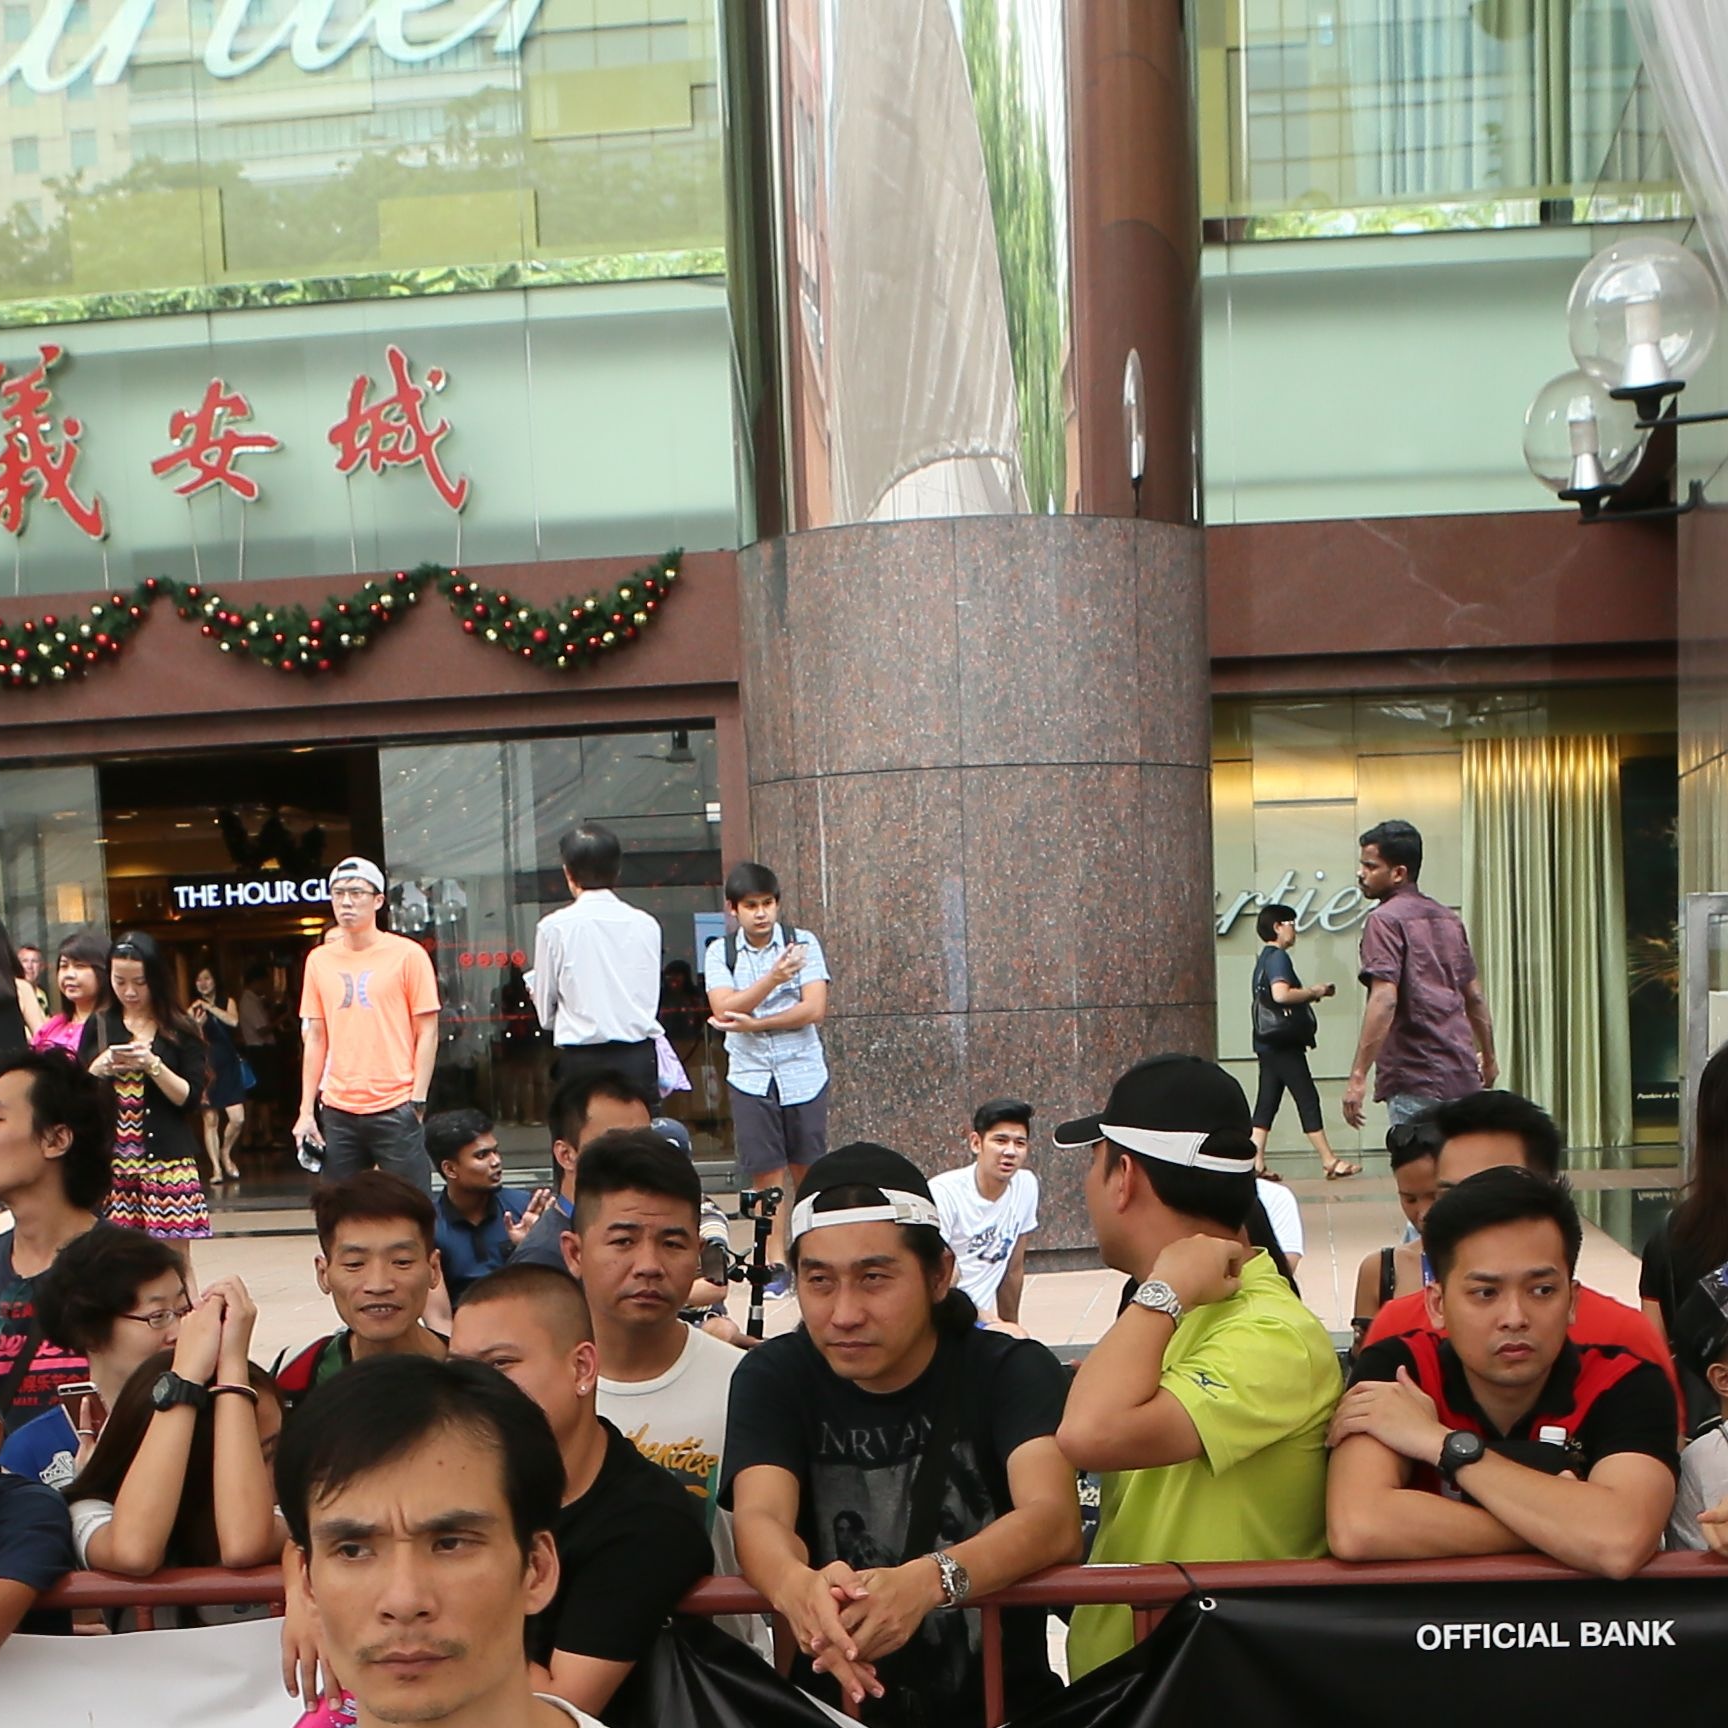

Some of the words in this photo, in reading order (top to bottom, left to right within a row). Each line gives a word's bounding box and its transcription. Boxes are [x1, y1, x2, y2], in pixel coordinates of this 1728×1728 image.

[174, 883, 221, 909] THE
[224, 880, 299, 907] HOUR
[1416, 1621, 1571, 1651] OFFICIAL
[1579, 1619, 1677, 1648] BANK
